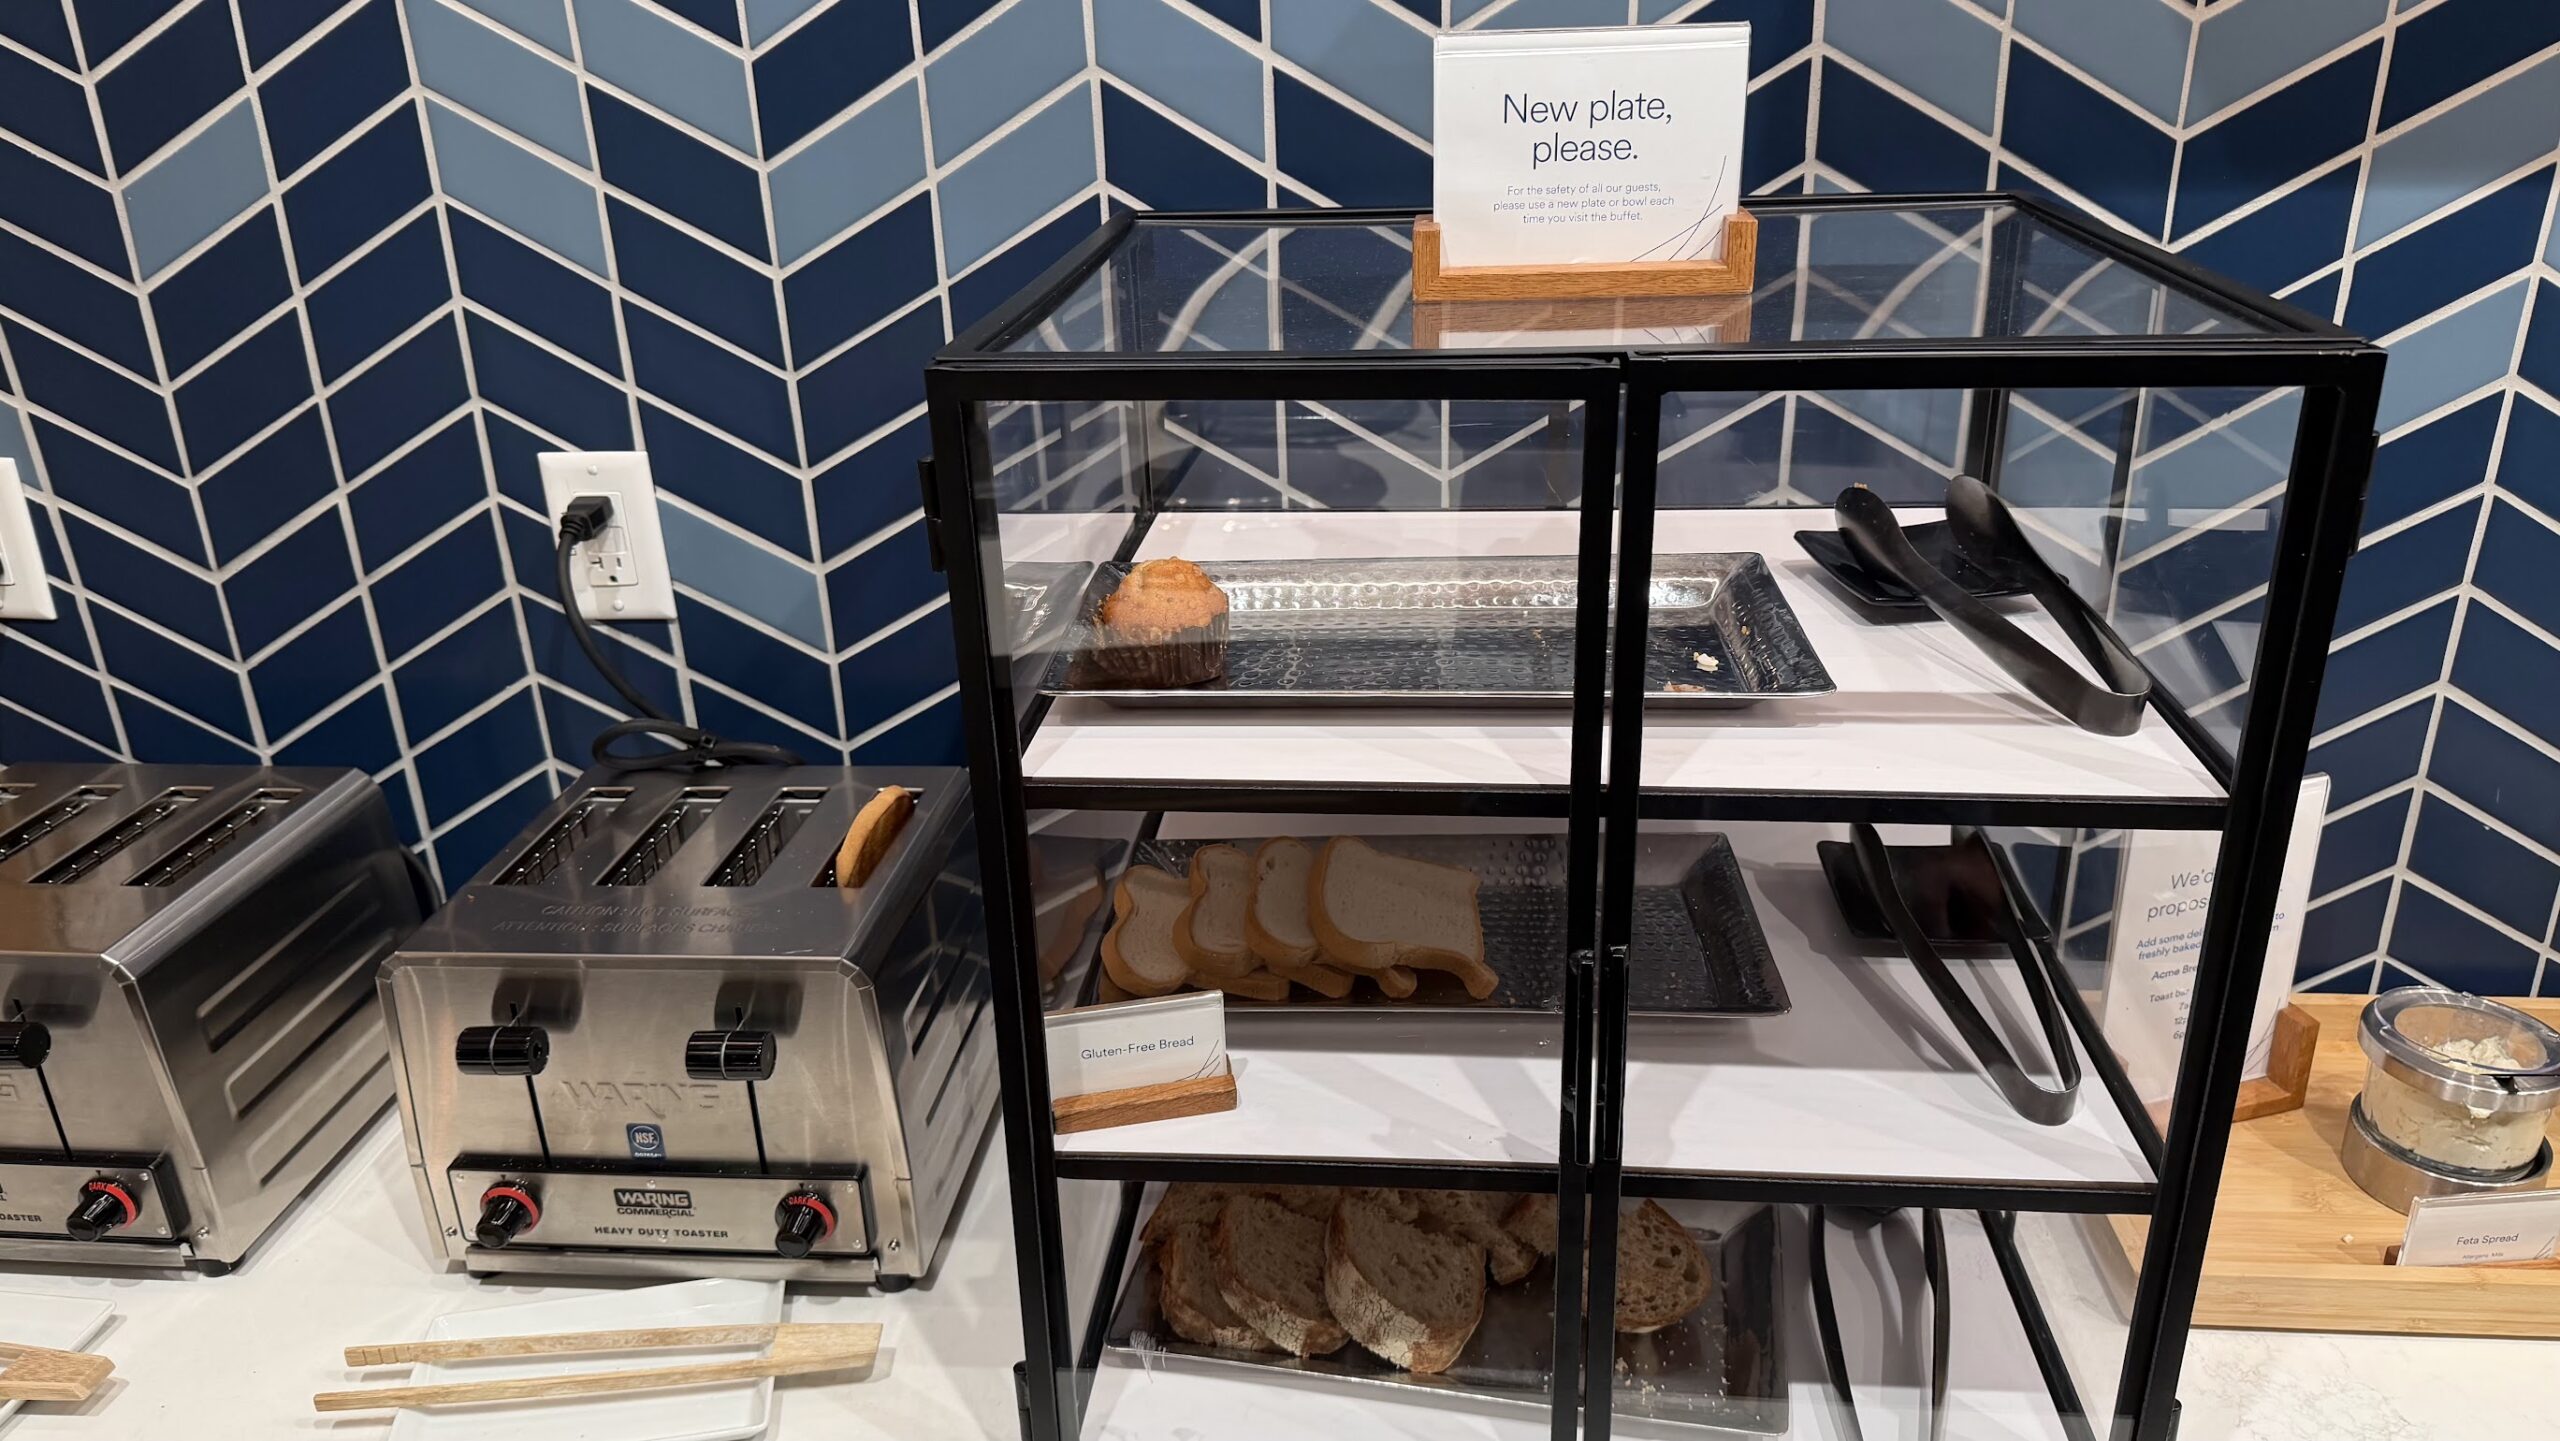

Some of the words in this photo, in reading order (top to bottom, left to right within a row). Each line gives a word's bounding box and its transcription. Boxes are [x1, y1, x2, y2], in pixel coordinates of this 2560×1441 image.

[1503, 92, 1578, 124] New
[1589, 89, 1672, 129] plate,
[1532, 131, 1639, 170] please.
[1507, 185, 1524, 196] For
[1527, 184, 1543, 195] the
[1546, 183, 1577, 196] safety
[1579, 183, 1589, 193] of
[1592, 183, 1603, 193] all
[1606, 184, 1622, 193] our
[1625, 182, 1661, 195] guests,
[1493, 201, 1525, 212] please
[1528, 201, 1546, 209] use
[1557, 200, 1579, 208] new
[1581, 198, 1606, 209] plate
[1609, 199, 1619, 207] or
[1622, 196, 1647, 207] bowl
[1649, 195, 1675, 206] each
[1523, 213, 1545, 224] time
[1547, 214, 1566, 224] you
[1568, 212, 1588, 222] visit
[1591, 211, 1607, 222] the
[1610, 209, 1643, 221] buffet.
[2170, 867, 2215, 889] We'd
[2146, 897, 2209, 922] propos
[2136, 936, 2157, 950] Add
[2158, 933, 2185, 946] some
[2186, 927, 2203, 940] del
[2138, 945, 2171, 960] freshly
[2150, 968, 2180, 981] Acme
[2182, 964, 2197, 975] Bre
[2149, 991, 2174, 1003] Toast
[2179, 1001, 2189, 1011] 7a
[2174, 1016, 2187, 1026] 12p
[2172, 1030, 2185, 1040] 6p
[1081, 1043, 1156, 1061] Gluten-Free
[1158, 1035, 1195, 1050] Bread
[634, 1131, 655, 1144] NSF
[616, 1191, 690, 1208] WARING
[0, 1213, 42, 1223] OASTER
[617, 1207, 695, 1219] COMMERCIAL
[594, 1226, 633, 1236] HEAVY
[637, 1228, 670, 1237] DUTY
[673, 1229, 729, 1238] TOASTER
[2456, 1236, 2480, 1246] Feta
[2481, 1232, 2520, 1246] Spread
